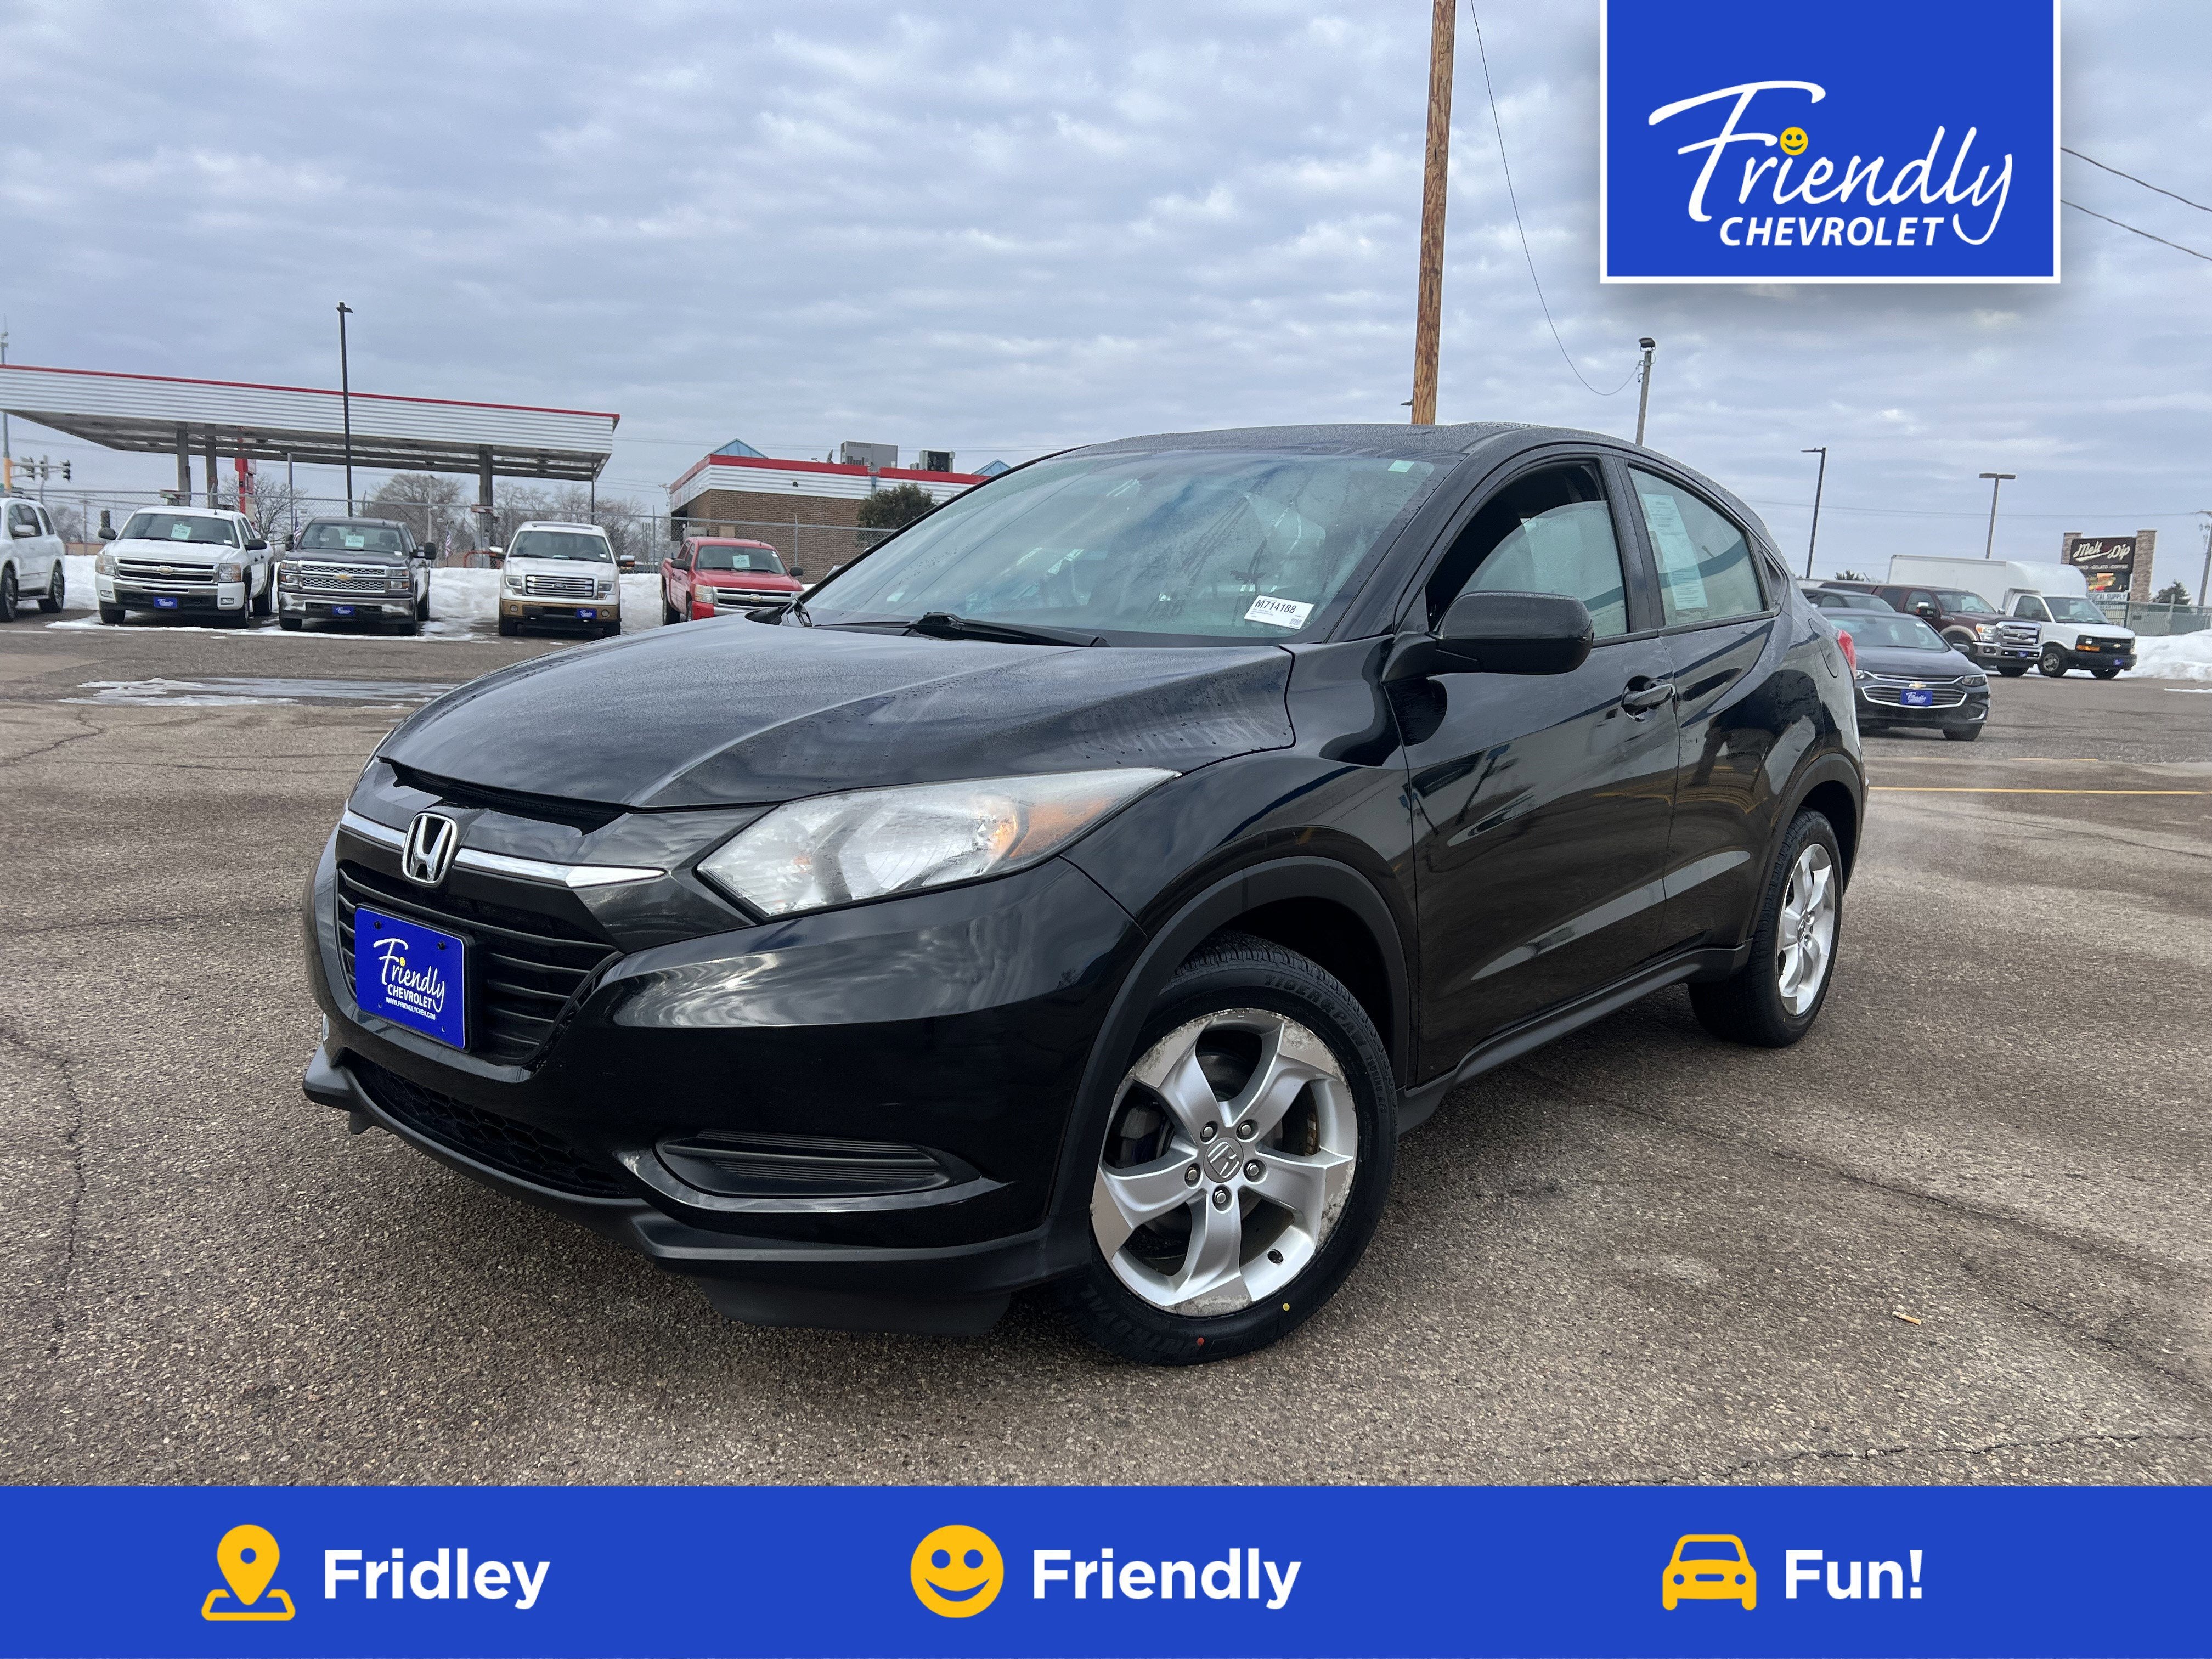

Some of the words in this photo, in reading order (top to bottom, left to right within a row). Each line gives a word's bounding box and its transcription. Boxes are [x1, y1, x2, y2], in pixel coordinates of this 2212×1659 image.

[2073, 541, 2103, 558] Melt
[2107, 543, 2131, 561] Dip
[1254, 600, 1297, 613] M714188
[374, 938, 445, 1013] Friendly
[387, 984, 432, 1009] CHEVROLET
